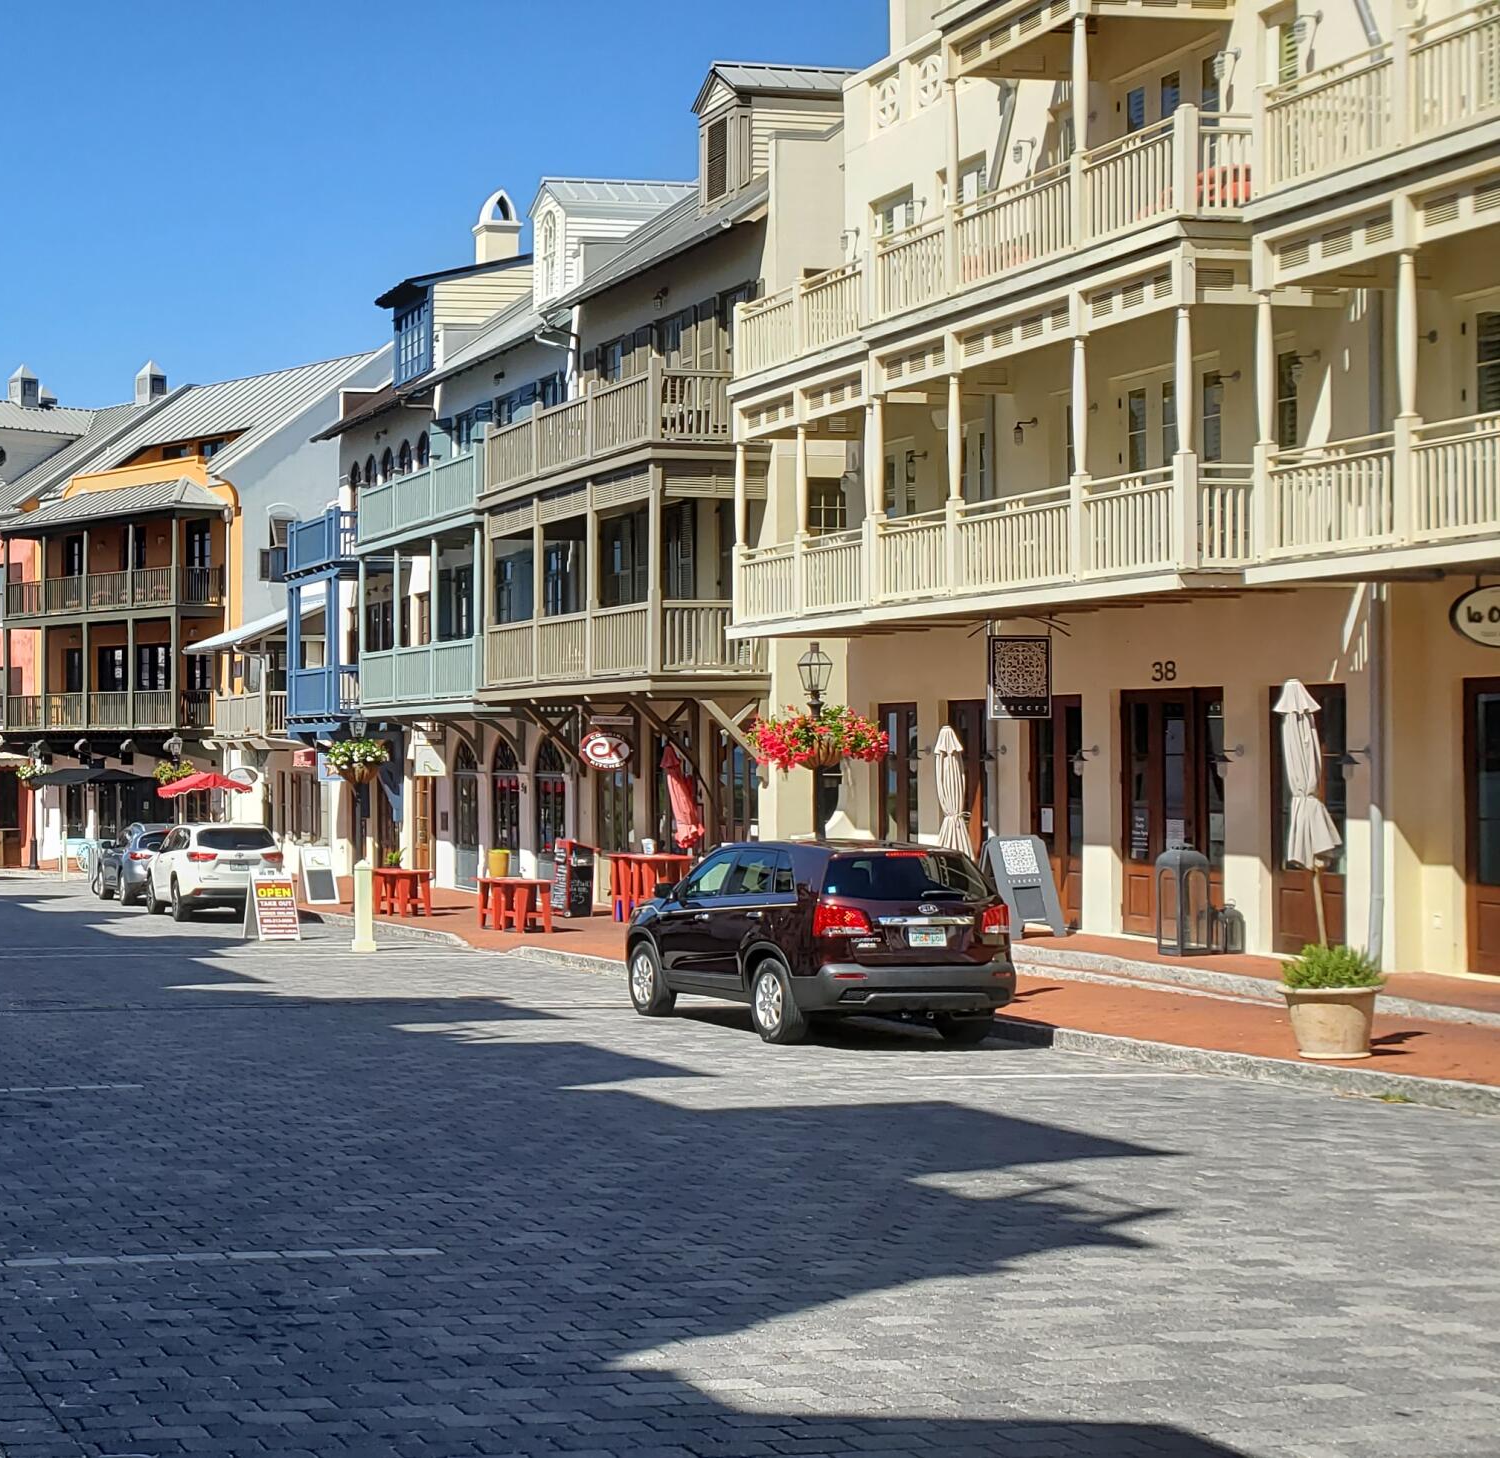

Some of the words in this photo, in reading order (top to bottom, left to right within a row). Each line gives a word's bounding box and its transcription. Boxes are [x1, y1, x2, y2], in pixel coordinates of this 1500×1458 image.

[1152, 661, 1177, 682] 38
[590, 742, 624, 758] CK
[257, 887, 292, 898] OPEN
